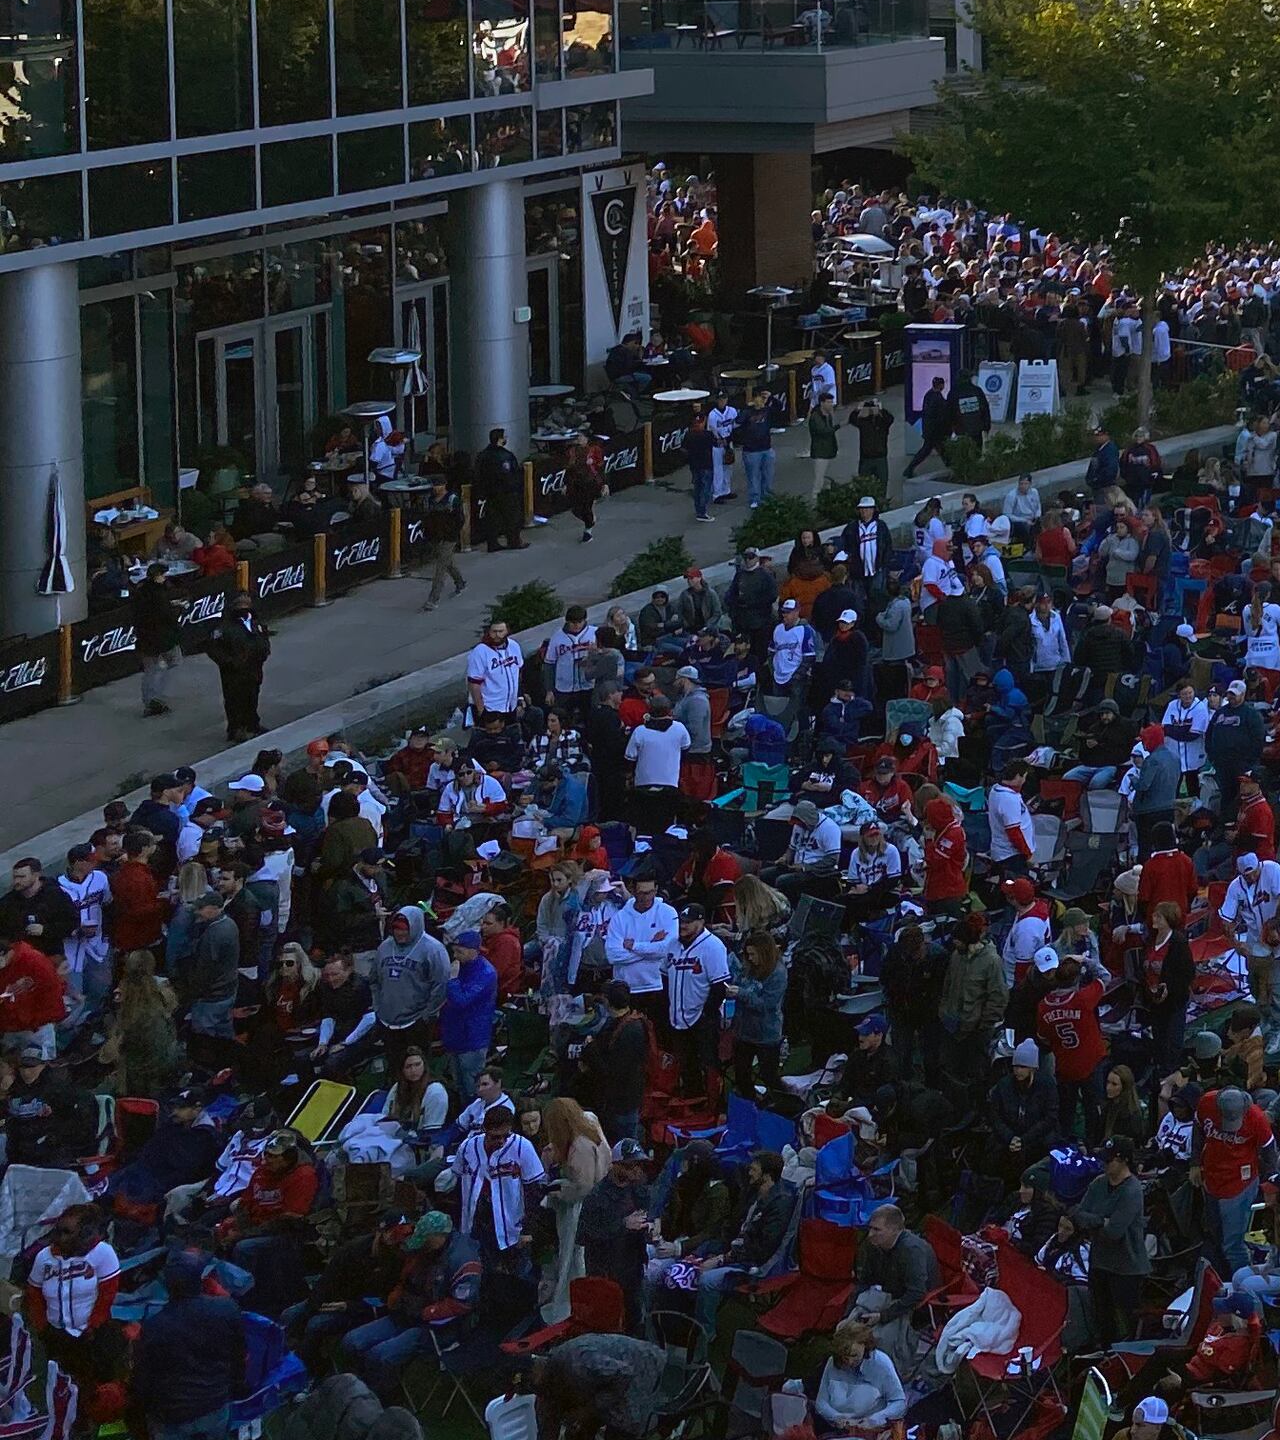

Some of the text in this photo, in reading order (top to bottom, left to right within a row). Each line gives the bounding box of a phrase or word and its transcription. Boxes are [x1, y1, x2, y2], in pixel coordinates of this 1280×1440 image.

[915, 530, 925, 546] 5
[1042, 1009, 1082, 1024] FREEMAN
[1055, 1022, 1082, 1049] 5
